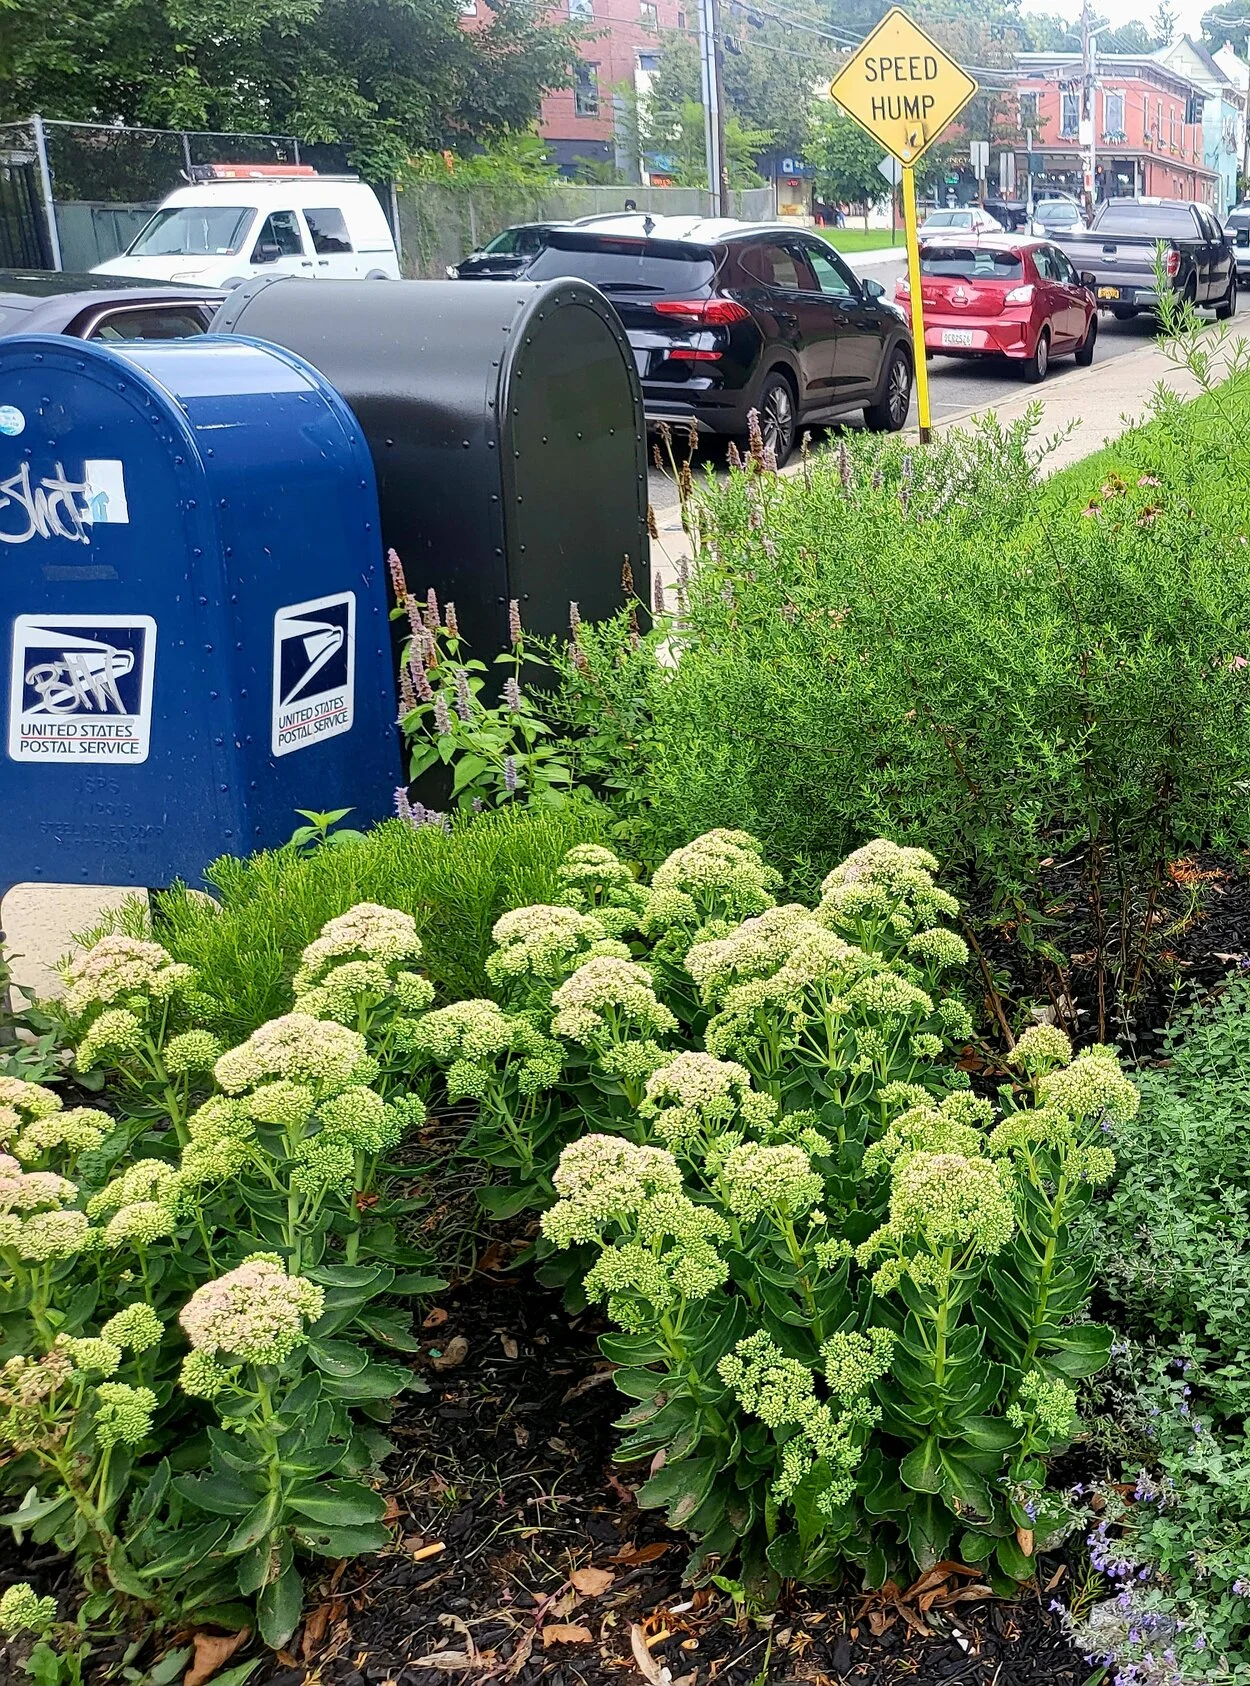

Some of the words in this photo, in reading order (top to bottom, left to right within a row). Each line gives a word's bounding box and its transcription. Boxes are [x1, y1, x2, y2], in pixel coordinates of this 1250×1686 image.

[865, 56, 938, 82] SPEED
[871, 95, 935, 120] HUMP
[279, 707, 313, 729] UNITED
[314, 696, 344, 717] STATES
[20, 723, 78, 737] UNITED
[80, 724, 133, 738] STATES
[278, 724, 312, 747] POSTAL
[313, 711, 349, 734] SERVICE
[20, 740, 76, 754] POSTAL
